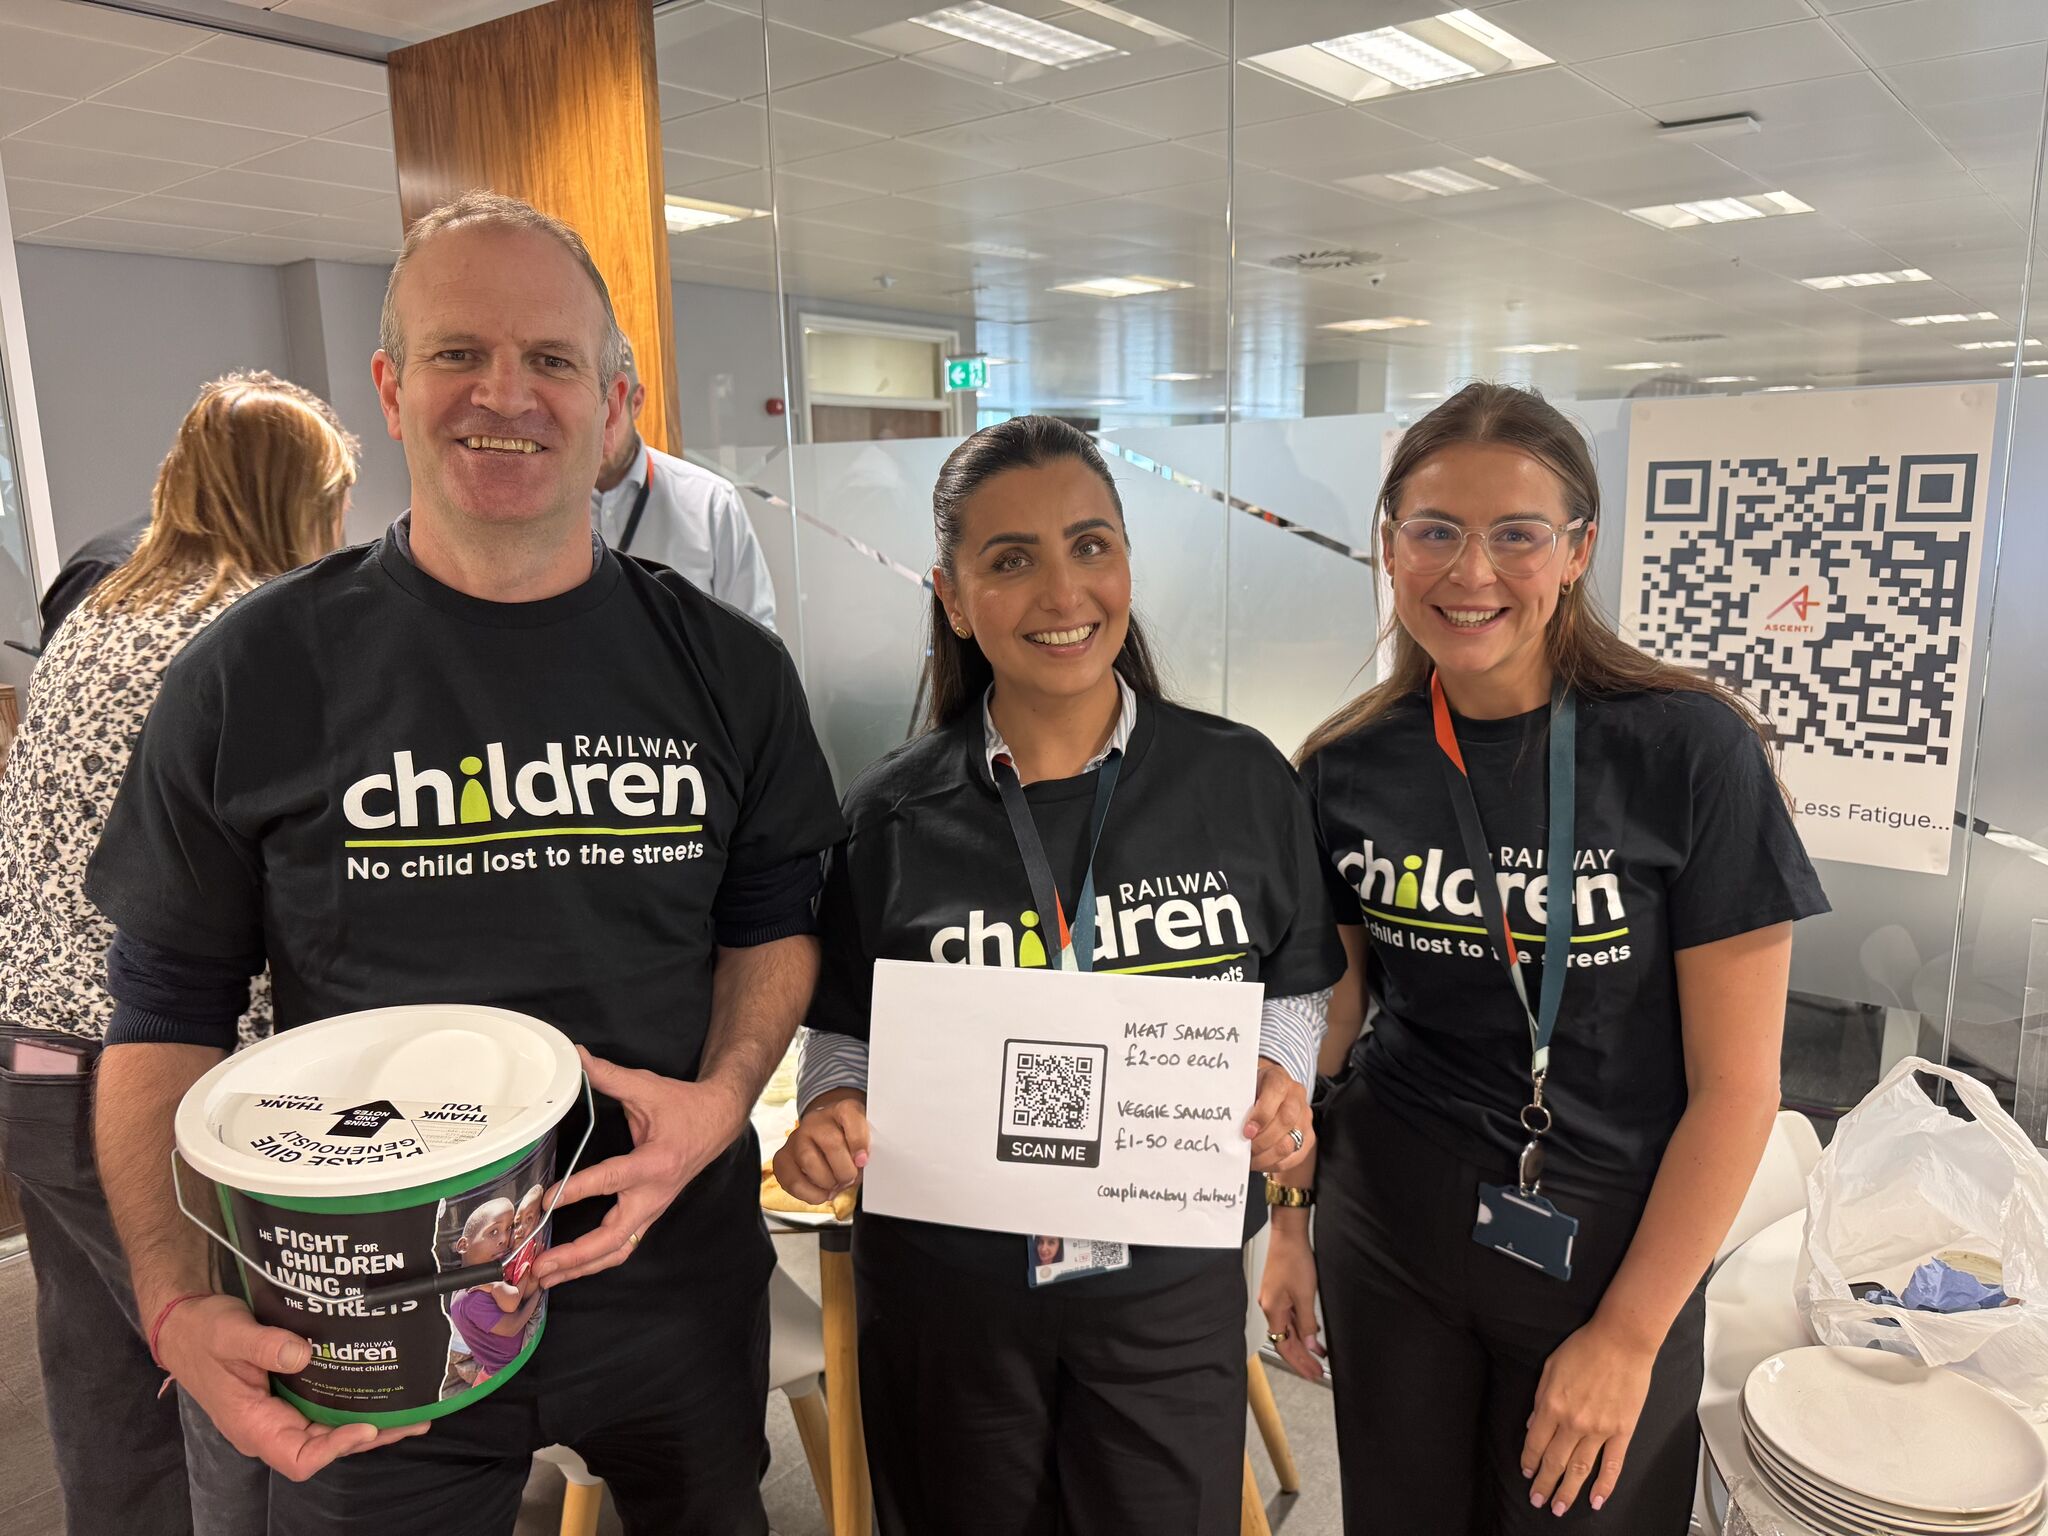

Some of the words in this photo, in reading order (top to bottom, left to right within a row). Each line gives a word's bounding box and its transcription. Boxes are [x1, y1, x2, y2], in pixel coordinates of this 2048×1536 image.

[1764, 624, 1814, 633] ASCENTI
[575, 735, 698, 760] RAILWAY
[343, 742, 706, 829] children
[1793, 797, 1841, 818] Less
[347, 857, 389, 880] No
[401, 853, 472, 878] child
[484, 848, 539, 873] lost
[546, 845, 571, 867] to
[580, 843, 625, 865] the
[632, 840, 705, 864] streets
[1500, 846, 1615, 870] RAIAY
[930, 893, 1249, 967] chidren
[1370, 922, 1404, 947] child
[1410, 931, 1453, 956] lost
[1458, 938, 1484, 958] to
[1124, 1022, 1168, 1039] MEAT
[1173, 1024, 1240, 1043] SAMOSA
[1187, 1052, 1229, 1069] each
[255, 1098, 325, 1112] THANK
[441, 1103, 482, 1112] YOU
[1117, 1100, 1169, 1119] VEGGIE
[1173, 1104, 1232, 1120] SAMOSA
[419, 1110, 487, 1122] THANK
[250, 1134, 301, 1164] GIVE
[278, 1130, 416, 1156] GENEROUSLY
[1011, 1141, 1057, 1159] SCAN
[1061, 1144, 1086, 1161] ME
[1174, 1134, 1220, 1153] each
[259, 1228, 273, 1242] WE
[274, 1226, 349, 1254] FIGHT
[354, 1243, 379, 1254] FOR
[280, 1249, 405, 1275] CHILDREN
[265, 1260, 340, 1297] LIVING
[345, 1287, 361, 1296] ON
[284, 1296, 304, 1311] THE
[307, 1338, 397, 1361] hildren
[354, 1340, 394, 1348] RAILWAY
[328, 1363, 340, 1371] for
[365, 1363, 399, 1372] children
